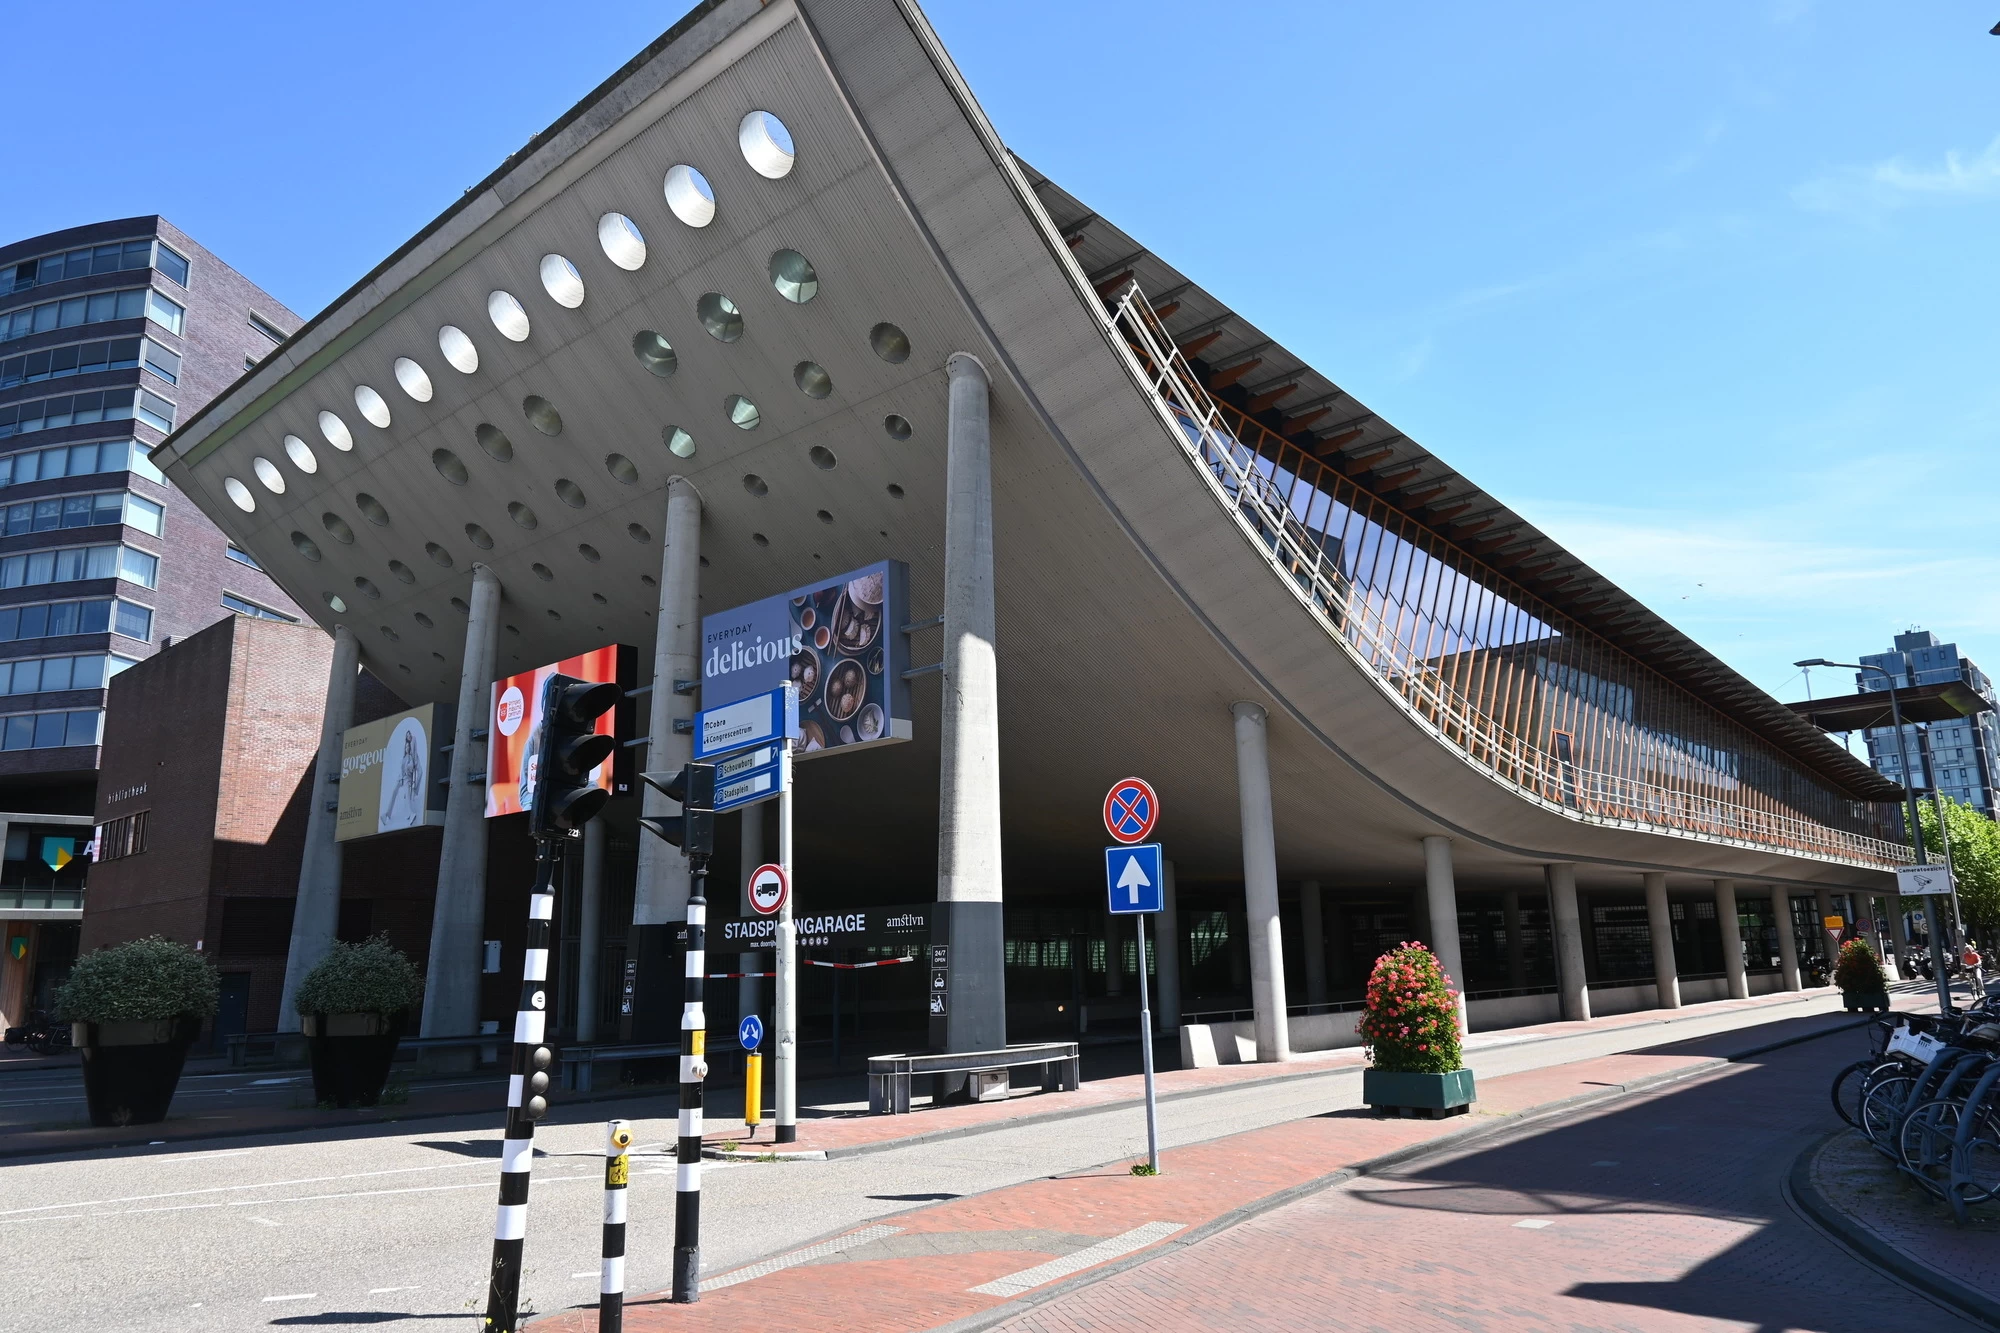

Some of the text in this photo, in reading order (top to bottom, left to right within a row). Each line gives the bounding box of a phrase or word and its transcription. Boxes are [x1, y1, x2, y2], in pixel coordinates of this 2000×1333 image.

[708, 623, 752, 643] EVERYDAY
[706, 633, 803, 678] delicious
[710, 720, 726, 729] Cobra
[709, 726, 753, 743] Congrescentrum
[724, 758, 753, 774] Schouwburg
[107, 781, 148, 804] bibliotheek
[724, 784, 749, 798] Stadsplein
